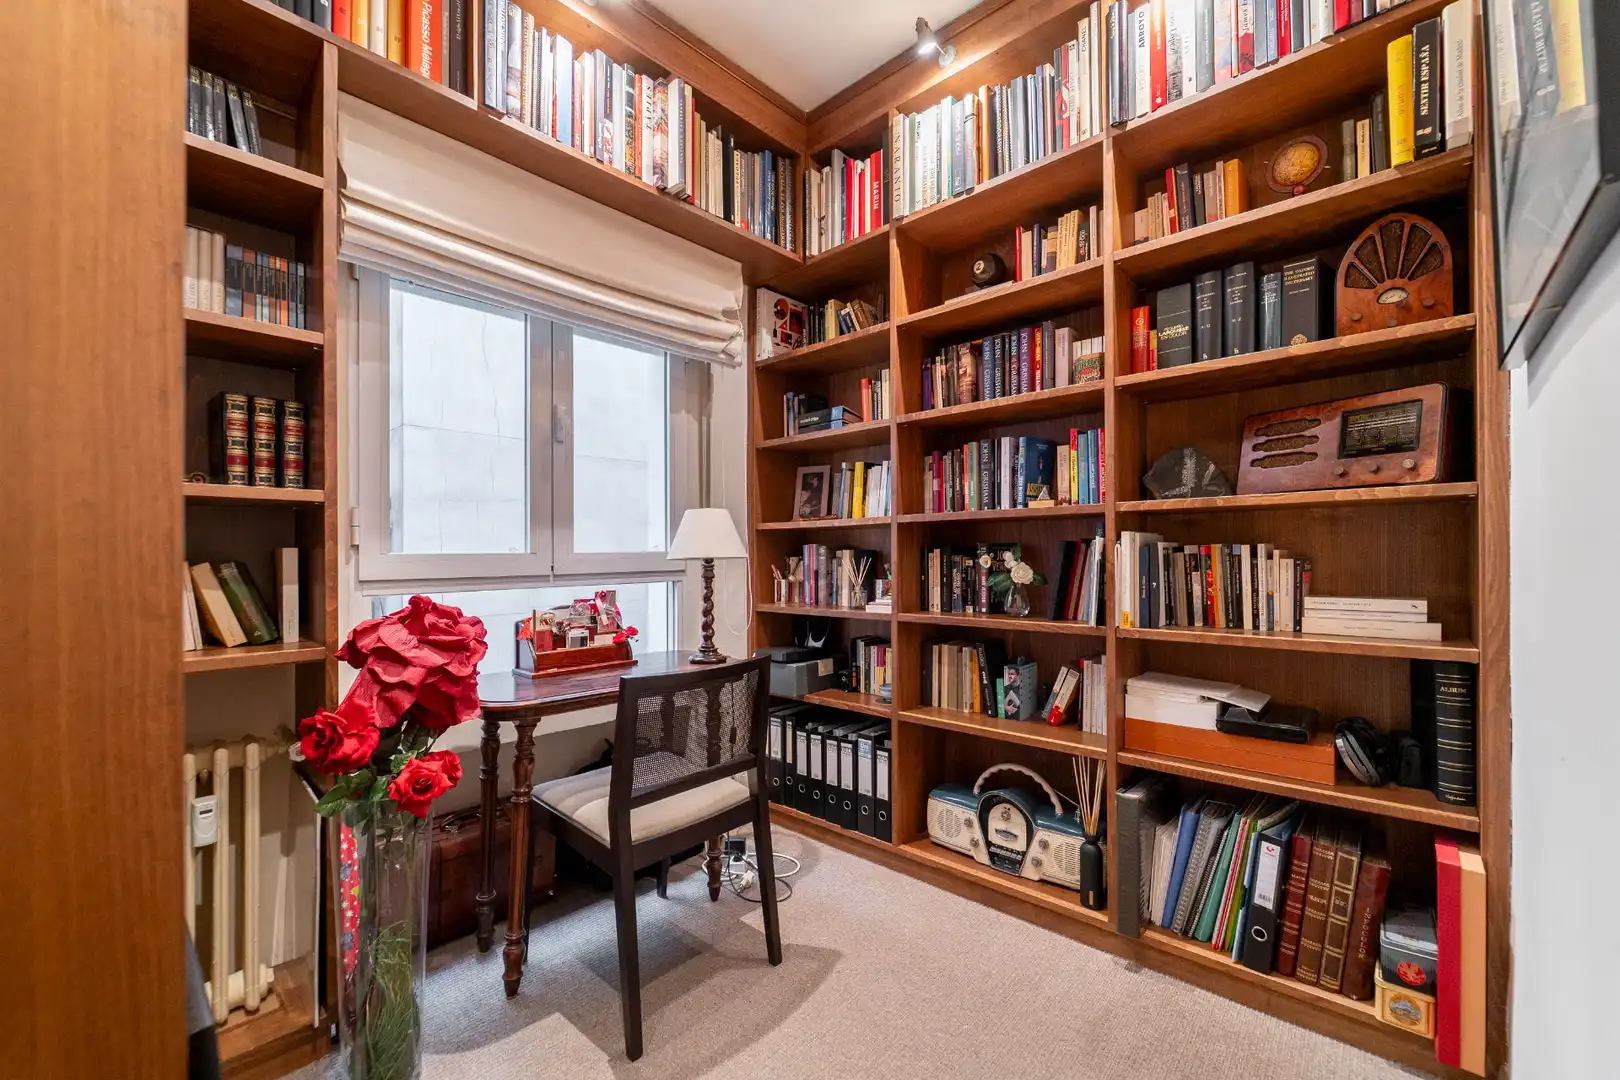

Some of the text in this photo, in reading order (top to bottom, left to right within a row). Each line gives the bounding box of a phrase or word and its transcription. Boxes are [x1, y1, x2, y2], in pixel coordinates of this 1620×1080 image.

[421, 2, 433, 43] Picasso
[1455, 39, 1463, 60] Madrid
[1420, 44, 1430, 116] SENTIR ESPAÑA
[893, 134, 901, 203] NARANJO
[1158, 326, 1190, 336] LAROUSSE
